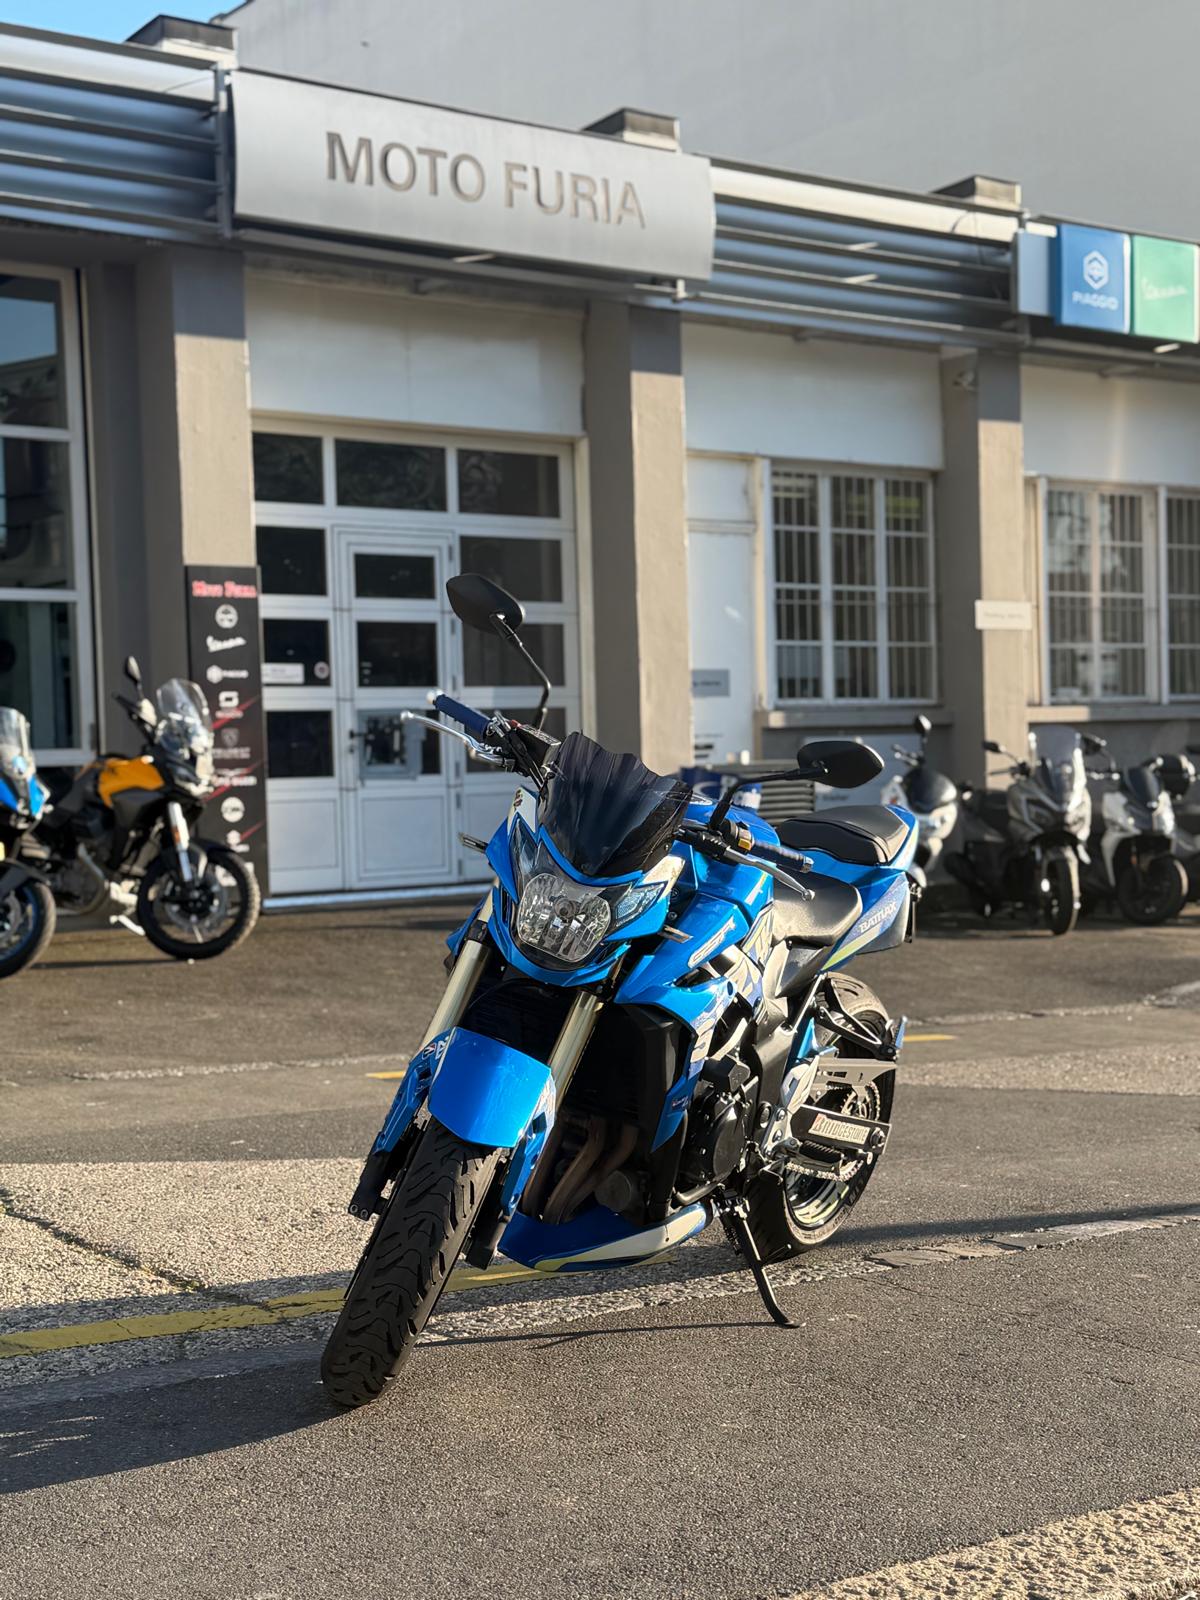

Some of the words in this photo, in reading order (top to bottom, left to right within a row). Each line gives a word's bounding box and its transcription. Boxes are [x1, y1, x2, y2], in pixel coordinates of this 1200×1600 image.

[326, 131, 485, 203] MOTO
[503, 161, 646, 229] FURIA
[1071, 291, 1119, 311] PIAGGIO
[809, 1113, 870, 1143] BRIDGESTONE
